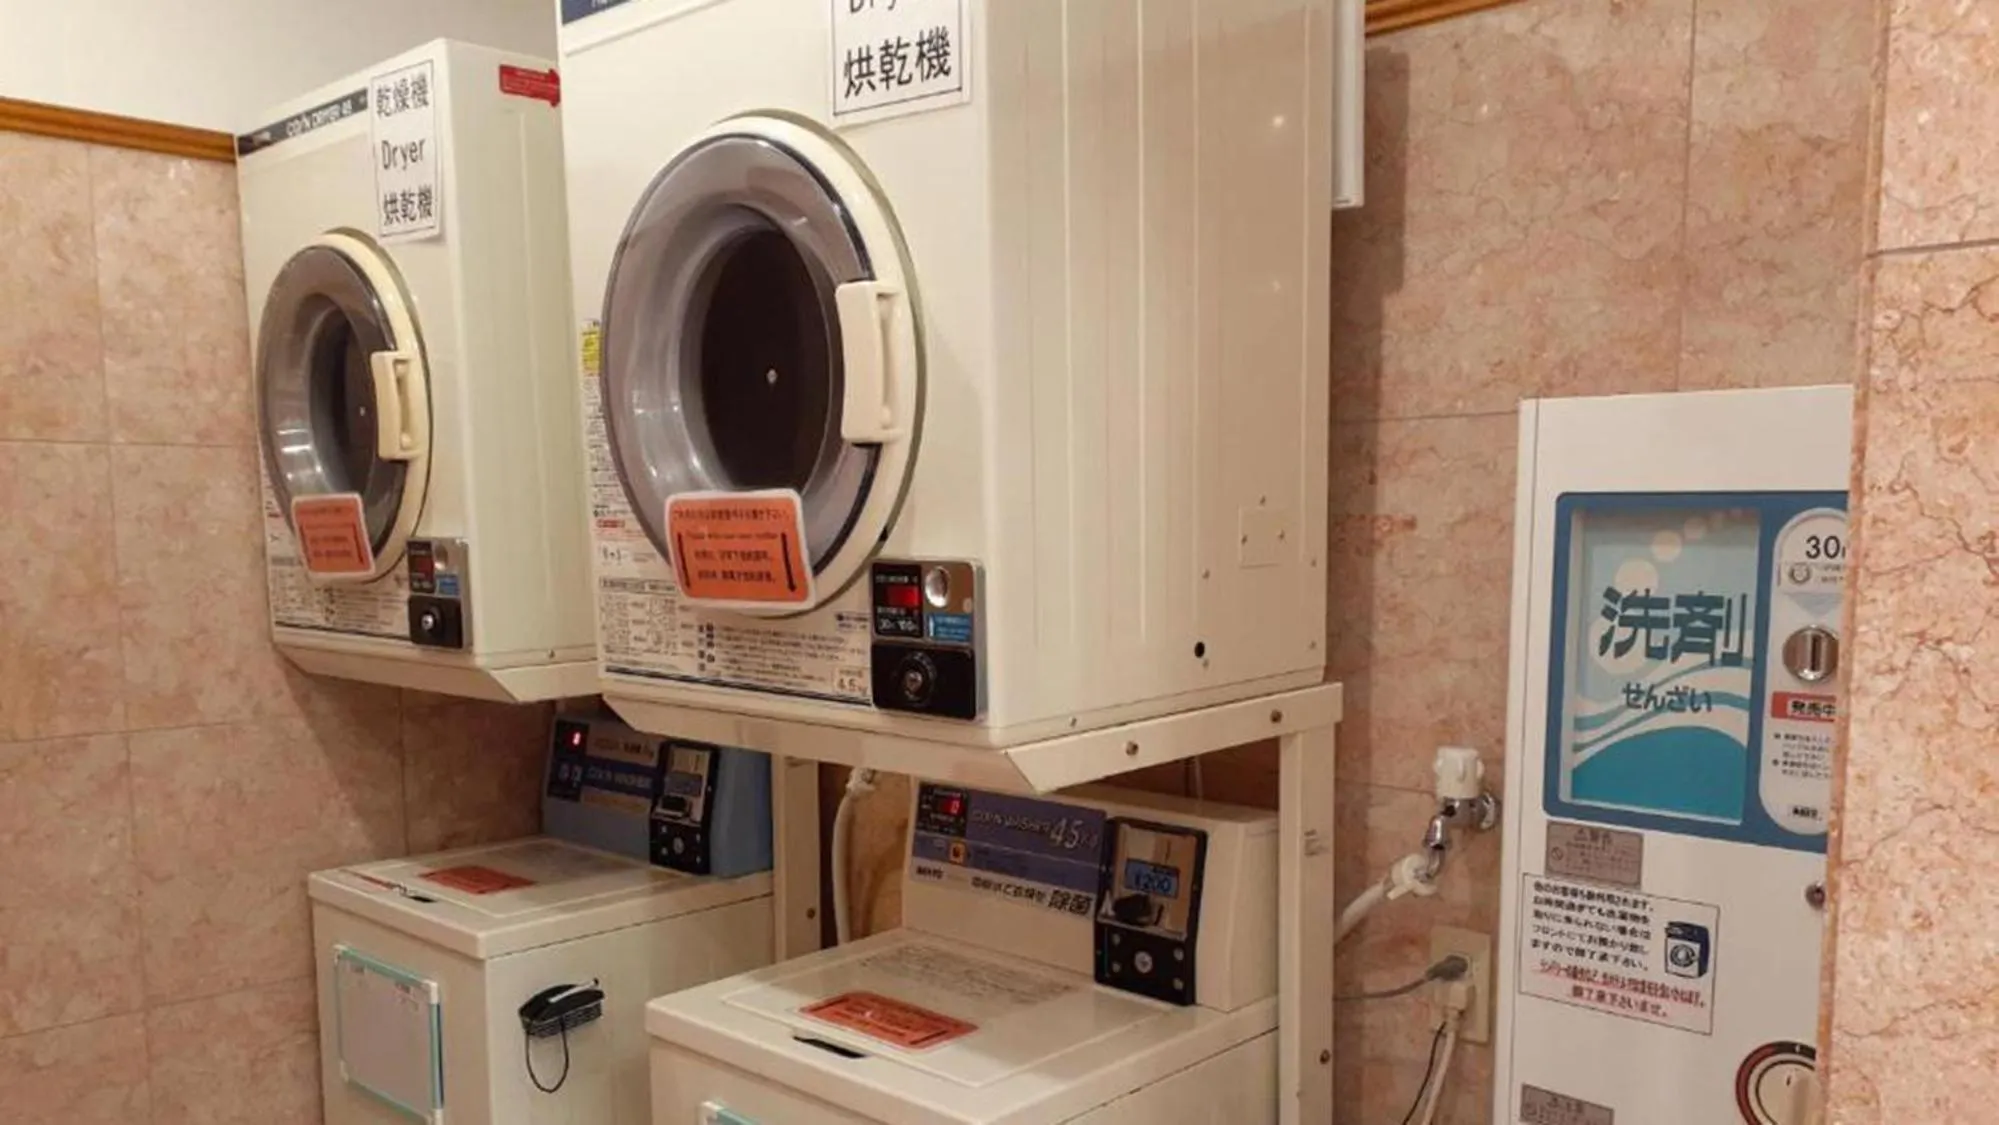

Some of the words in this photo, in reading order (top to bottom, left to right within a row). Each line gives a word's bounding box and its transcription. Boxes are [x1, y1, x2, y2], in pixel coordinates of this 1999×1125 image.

[844, 26, 951, 99] 烘乾機
[377, 73, 429, 117] 乾燥機
[382, 139, 425, 170] Dryer
[383, 183, 433, 226] 烘乾機
[1598, 586, 1748, 667] 洗剤
[1621, 683, 1713, 714] せんざい
